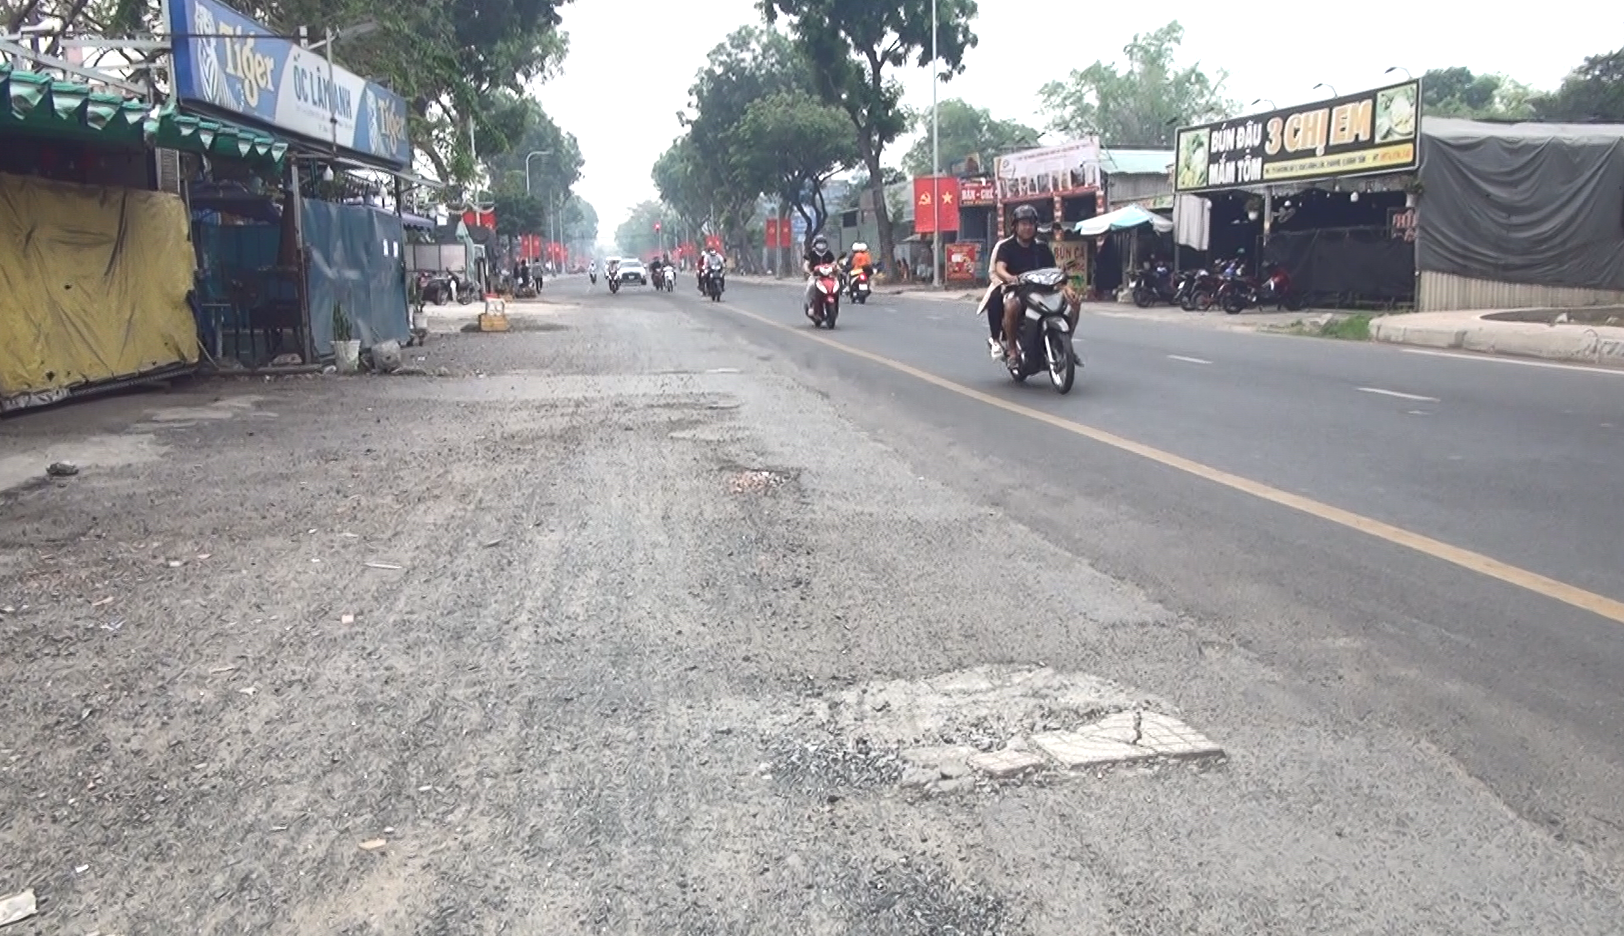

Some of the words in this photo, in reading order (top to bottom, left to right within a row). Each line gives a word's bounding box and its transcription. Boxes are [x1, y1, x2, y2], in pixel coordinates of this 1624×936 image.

[218, 21, 275, 108] Tiger
[377, 98, 406, 155] Tiger
[1211, 123, 1235, 153] BÚN
[1236, 120, 1262, 153] ĐẬU
[1266, 117, 1284, 154] 3
[1284, 109, 1329, 156] CHỊ
[1330, 100, 1373, 145] EM
[1208, 153, 1236, 186] MẮM
